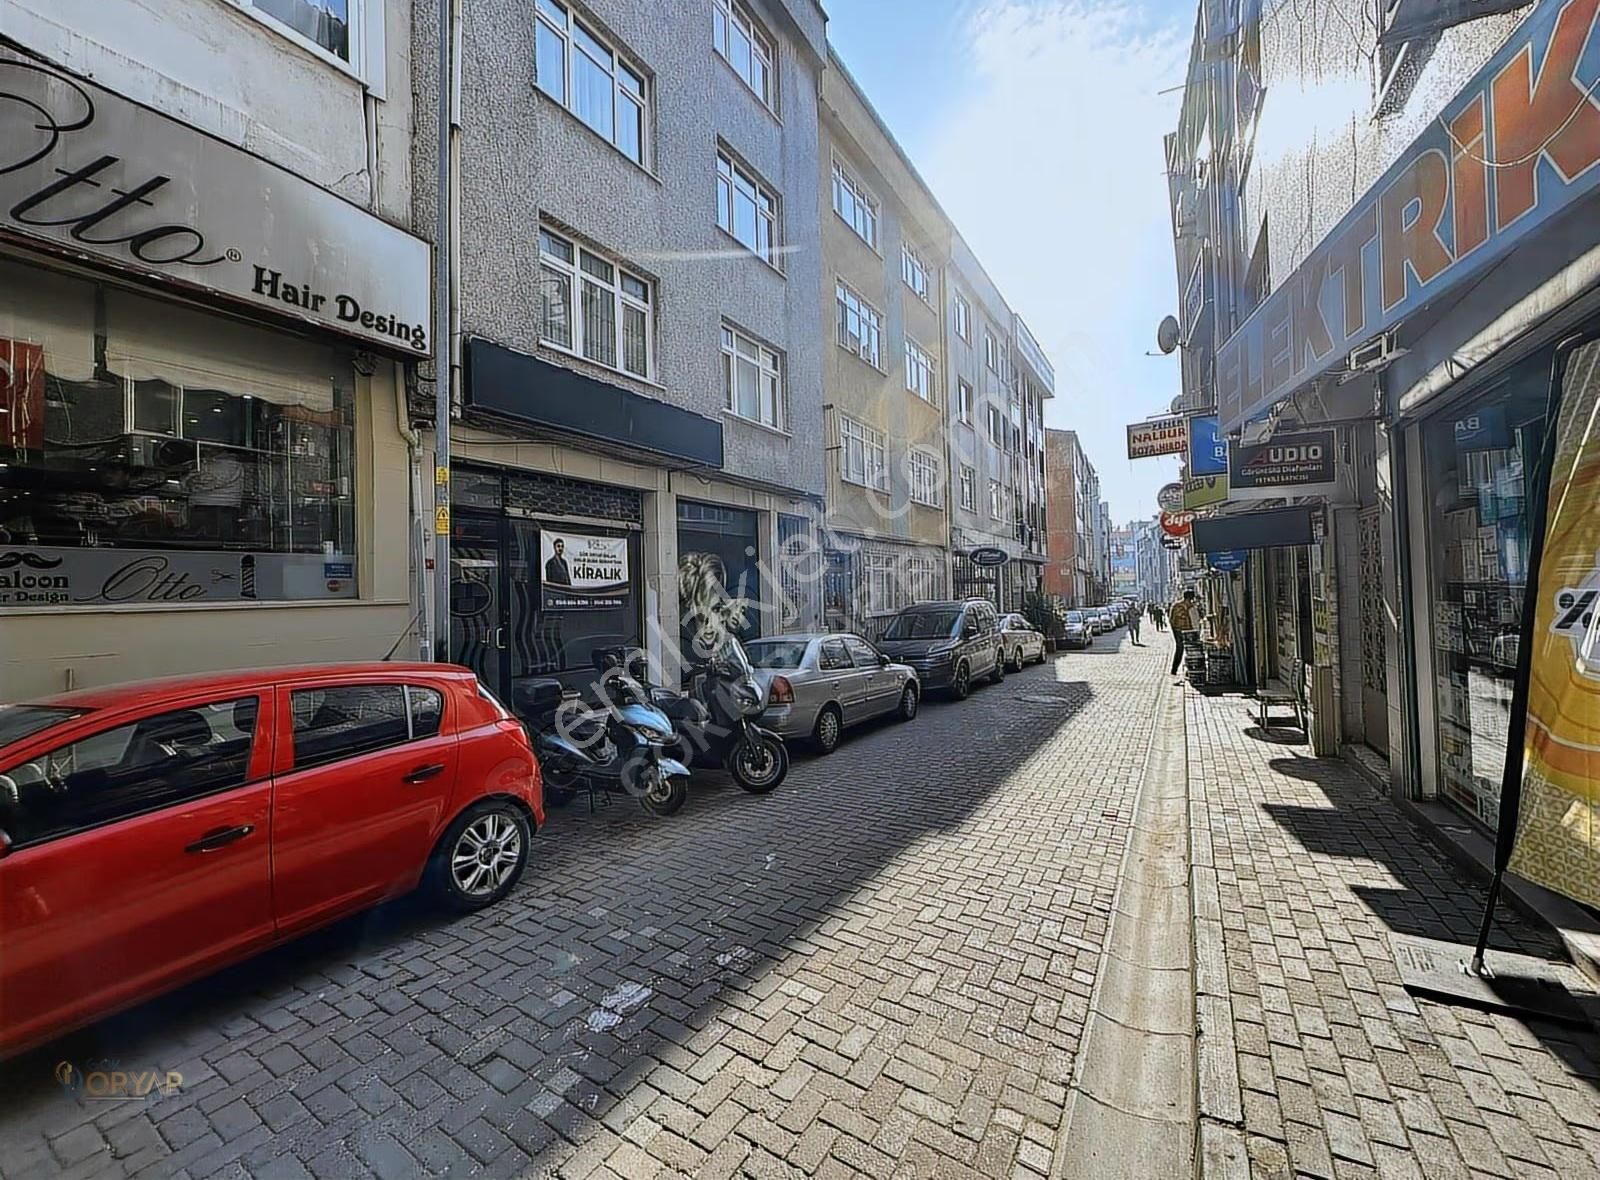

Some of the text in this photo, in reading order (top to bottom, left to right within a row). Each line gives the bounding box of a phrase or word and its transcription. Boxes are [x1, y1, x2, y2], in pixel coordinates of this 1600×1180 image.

[252, 264, 427, 351] Hair Desing
[1247, 445, 1323, 465] AUDIO
[73, 556, 208, 601] Otto
[573, 563, 623, 580] KİRALIK
